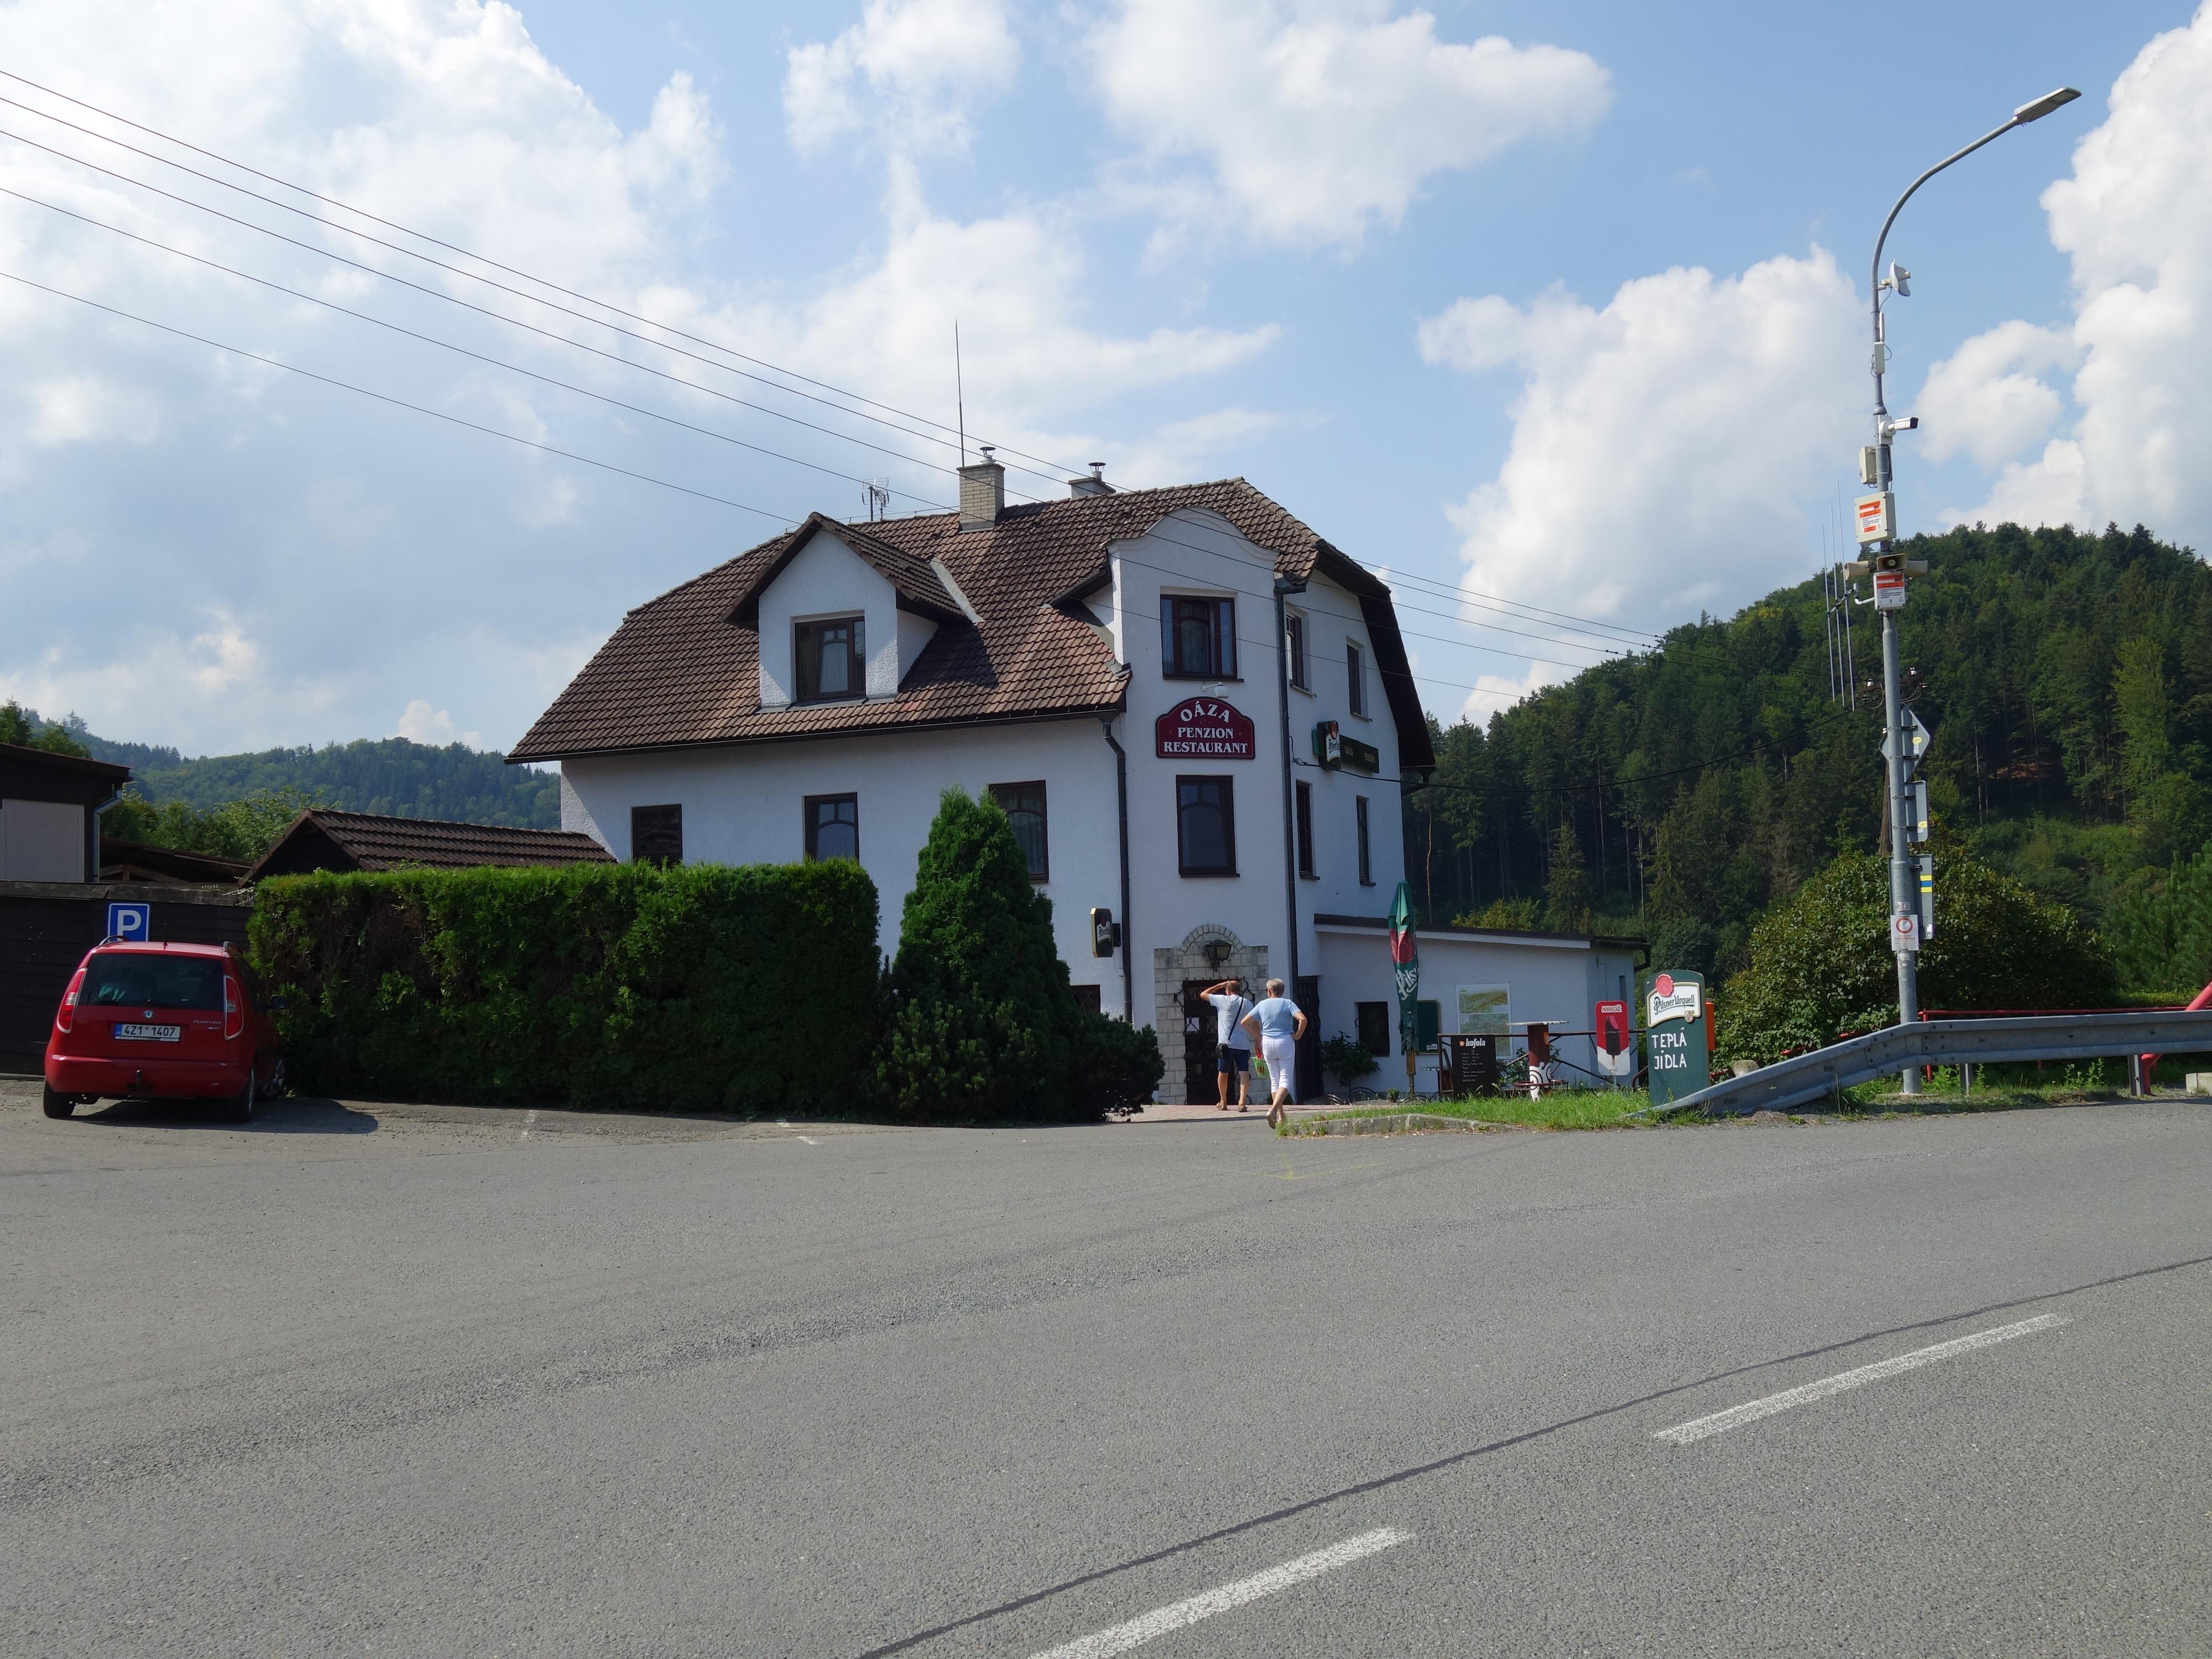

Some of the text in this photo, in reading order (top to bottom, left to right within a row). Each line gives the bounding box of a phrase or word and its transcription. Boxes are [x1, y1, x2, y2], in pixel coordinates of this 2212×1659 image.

[1180, 700, 1230, 723] OÁZA
[1177, 727, 1234, 739] PENZION
[1164, 742, 1248, 753] RESTAURANT
[117, 910, 141, 941] P
[1396, 968, 1417, 1000] Pils
[1601, 1004, 1623, 1013] MROŽ
[1653, 994, 1695, 1015] Pilsner Urquell
[124, 1025, 176, 1037] 4Z1 1407
[1651, 1027, 1687, 1049] TEPLÁ
[1465, 1038, 1486, 1048] kofola
[1654, 1050, 1687, 1070] JÍDLA
